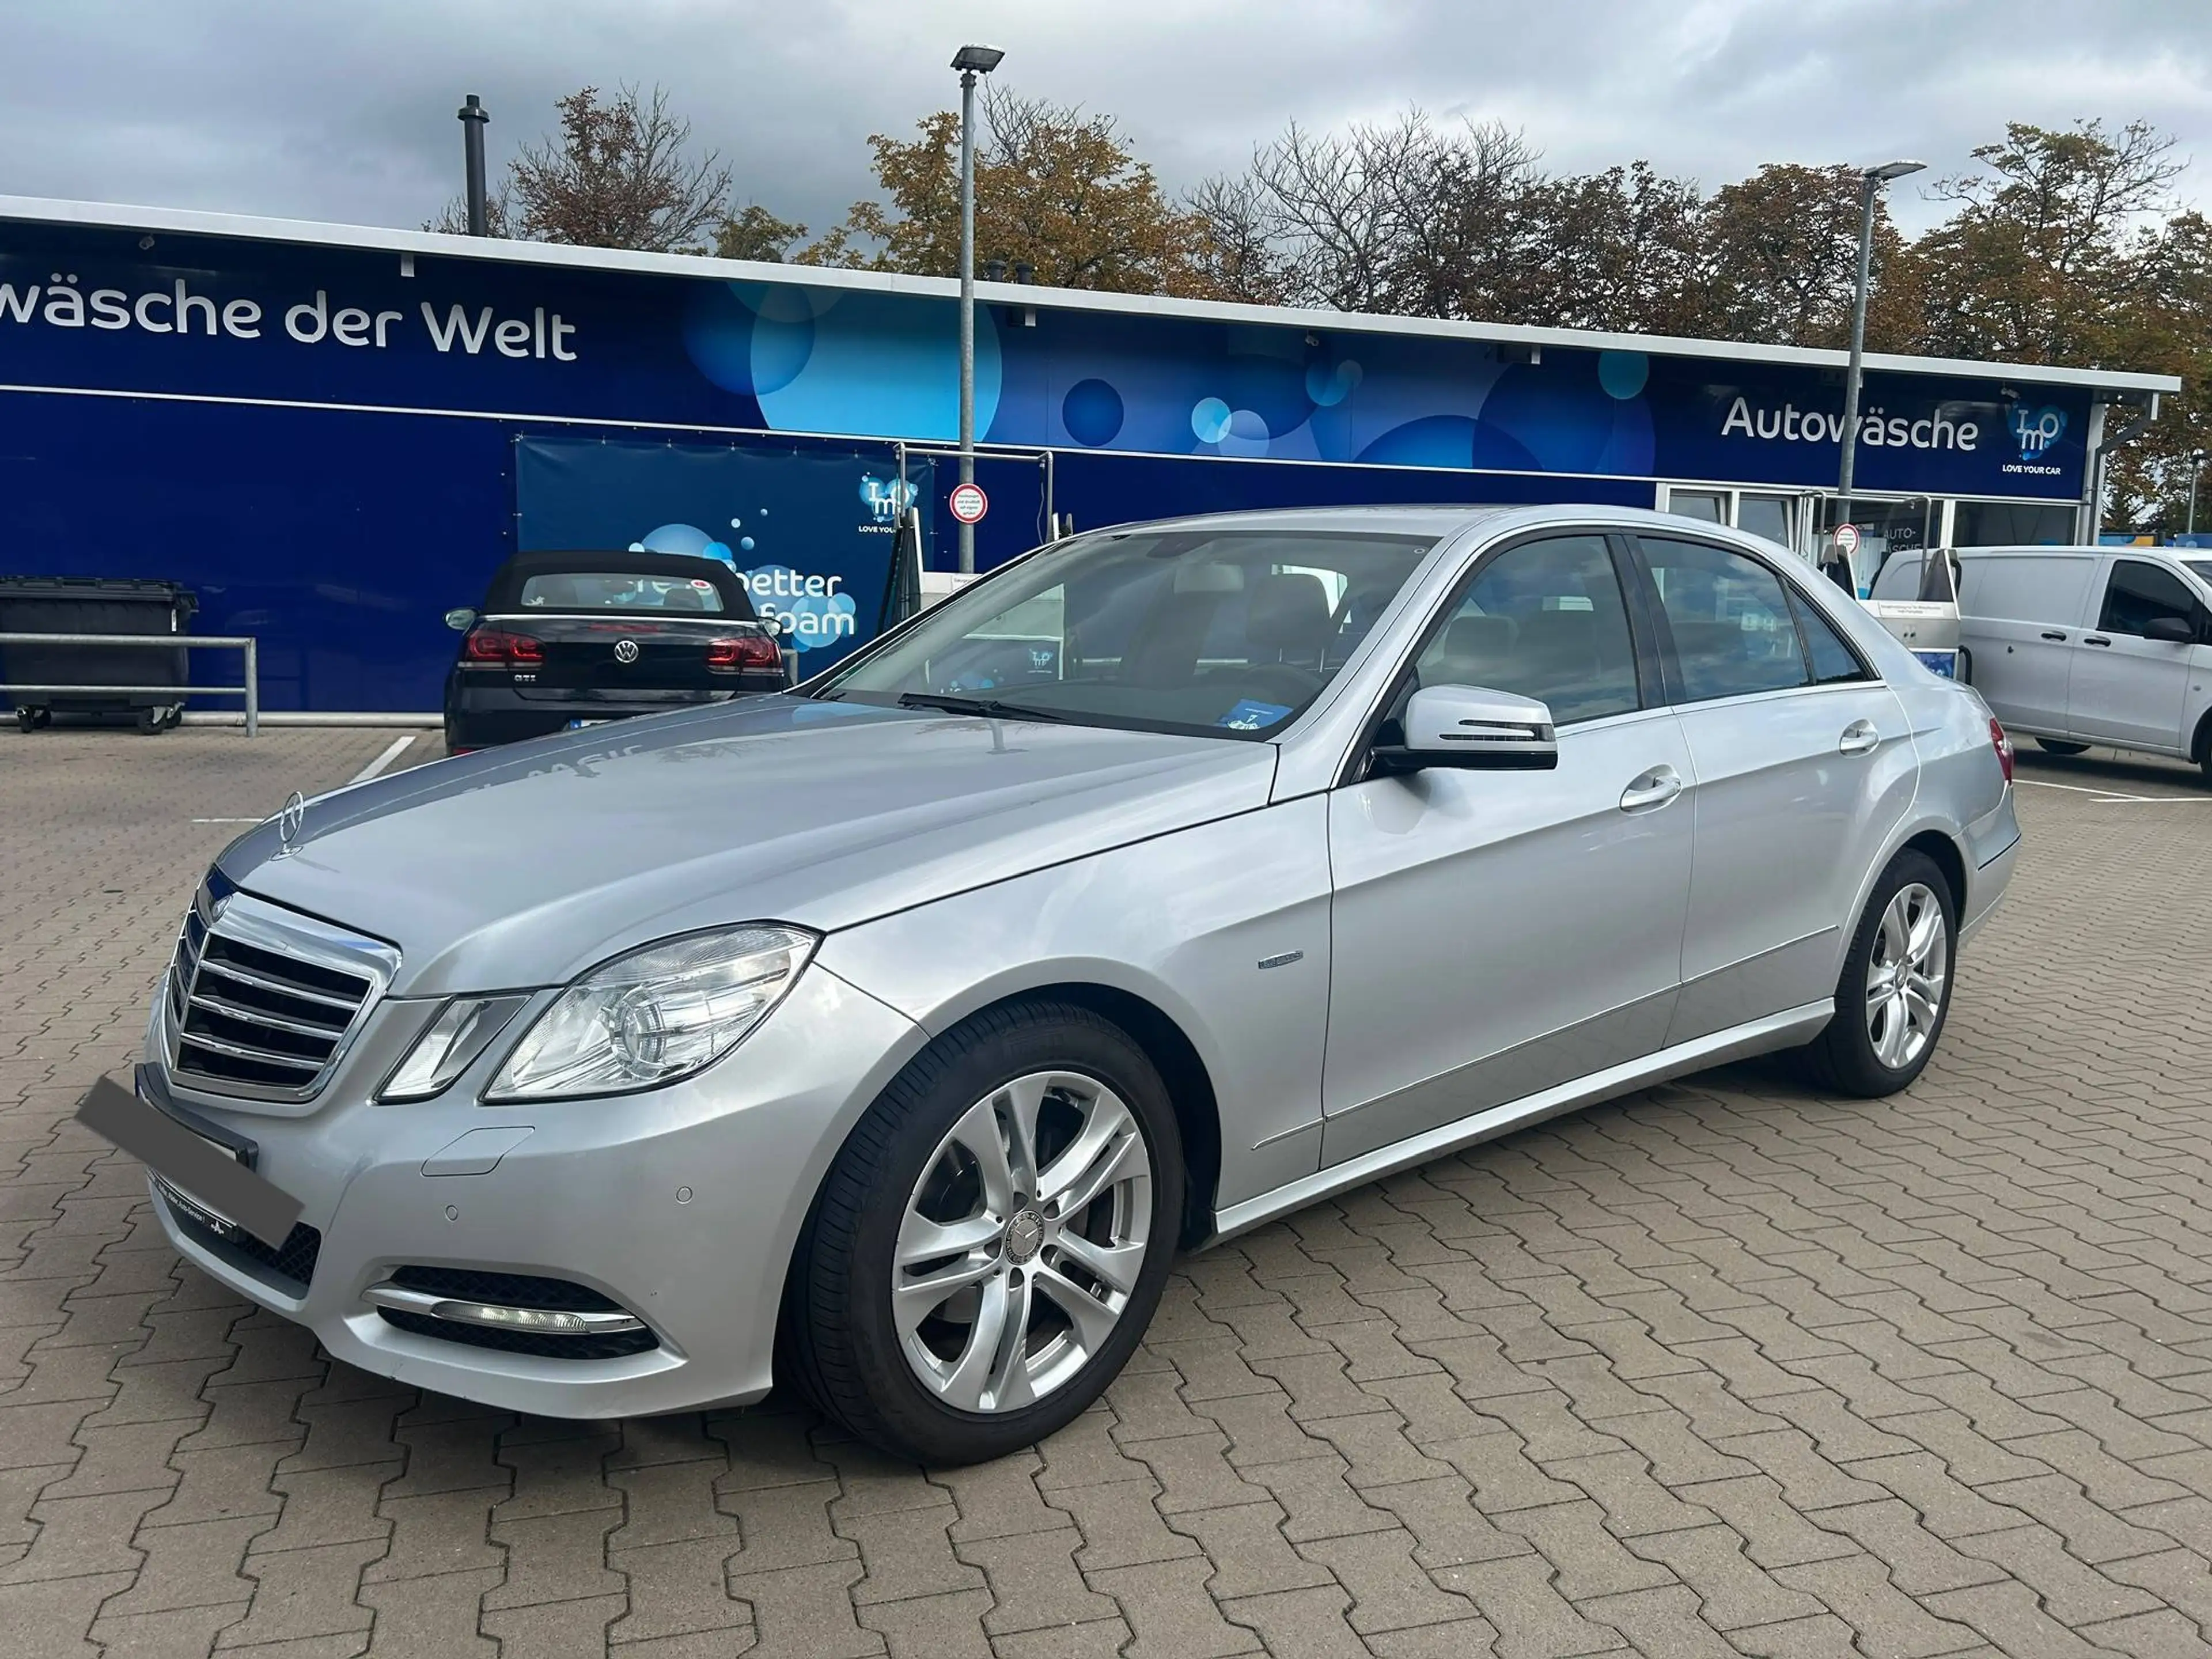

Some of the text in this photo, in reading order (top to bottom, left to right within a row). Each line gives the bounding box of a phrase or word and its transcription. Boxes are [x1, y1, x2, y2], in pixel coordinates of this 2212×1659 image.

[0, 272, 577, 361] wäsche der Welt
[1721, 397, 1979, 450] Autowäsche
[2002, 464, 2061, 475] LOVE YOUR CAR
[759, 603, 854, 635] foam
[514, 674, 536, 682] GTI
